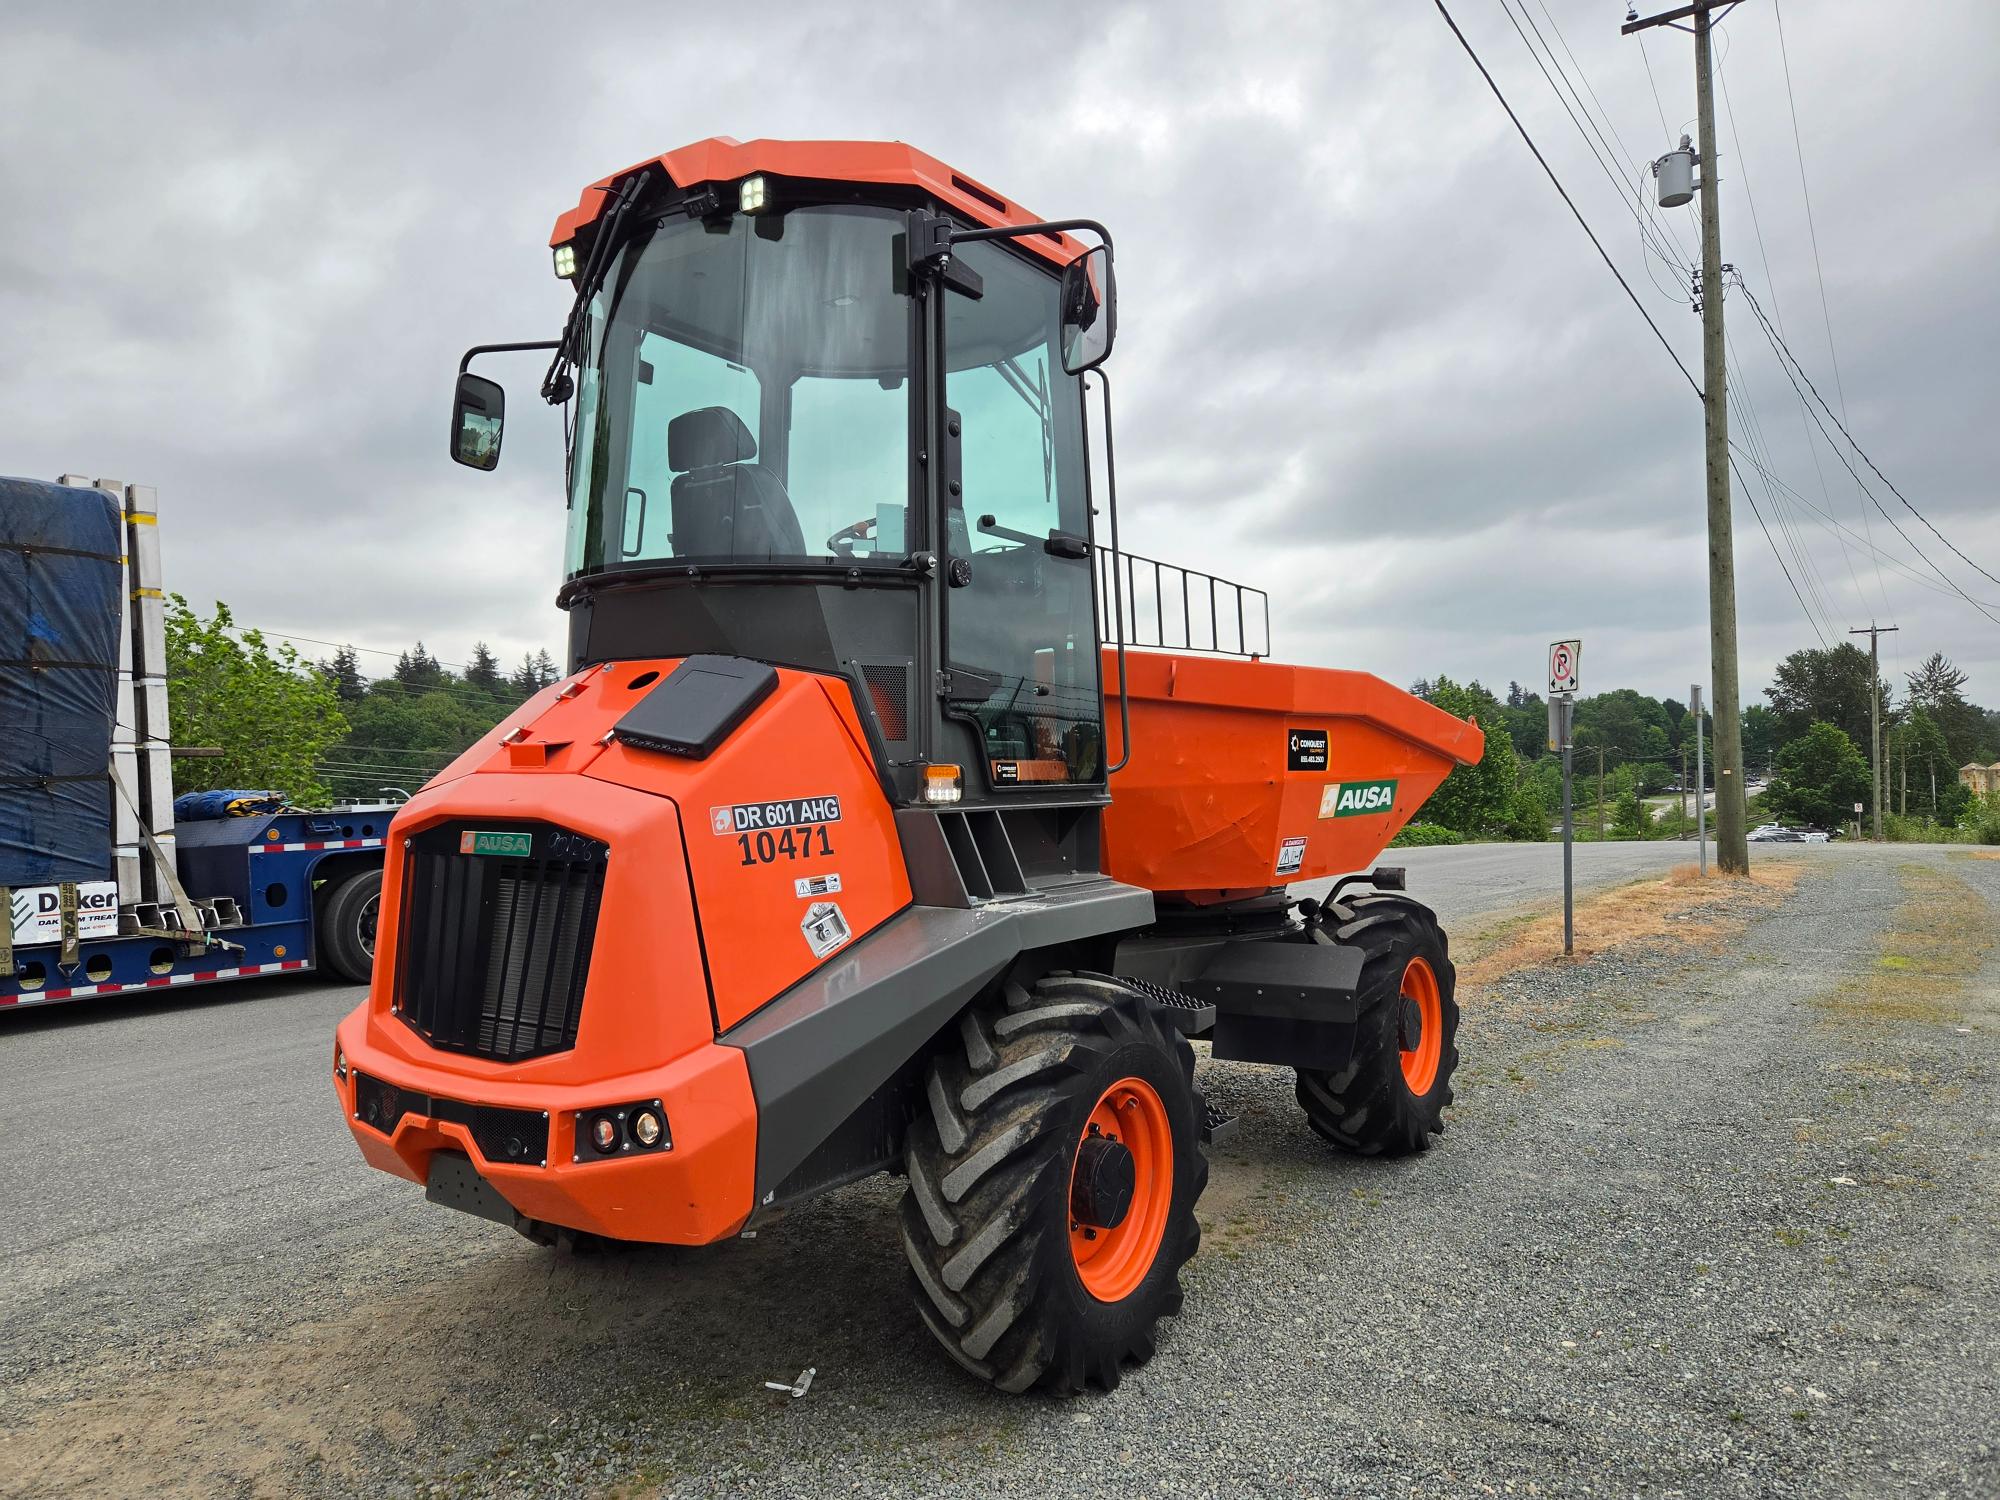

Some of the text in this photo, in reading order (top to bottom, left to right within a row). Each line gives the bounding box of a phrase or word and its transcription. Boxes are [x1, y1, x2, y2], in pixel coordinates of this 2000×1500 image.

[1300, 740, 1325, 748] CONQUEST
[1337, 786, 1392, 811] AUSA
[734, 798, 839, 829] DR 601 AHG
[477, 836, 529, 852] AUSA
[738, 825, 834, 866] 10471
[88, 914, 117, 922] TREAT
